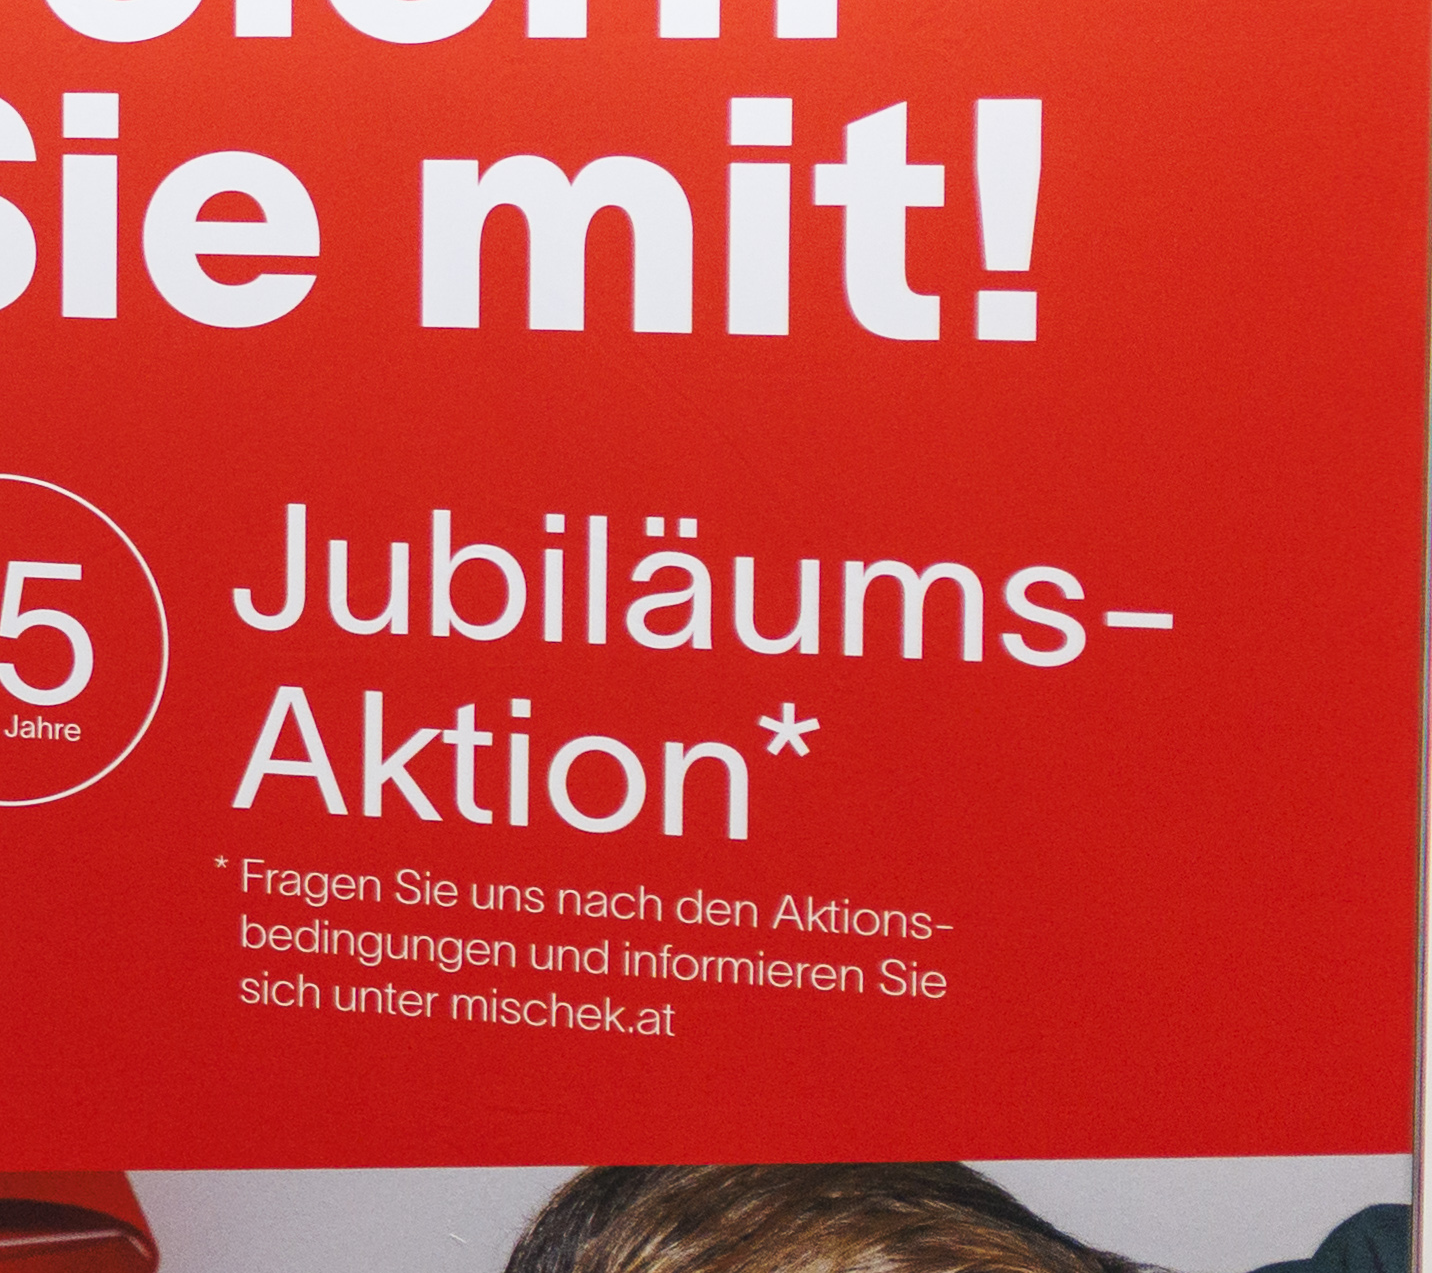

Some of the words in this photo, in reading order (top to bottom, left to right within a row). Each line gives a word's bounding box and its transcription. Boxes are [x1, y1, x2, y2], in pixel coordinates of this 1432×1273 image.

[420, 96, 1043, 343] mit!
[232, 502, 1177, 669] Jubiläums-
[4, 714, 82, 742] Jahre
[394, 867, 460, 909] Sie
[471, 881, 546, 915] uns
[557, 882, 663, 923] nach
[676, 887, 760, 930] den
[771, 894, 955, 941] Aktions-
[240, 913, 517, 974] bedingungen
[529, 936, 610, 977] und
[623, 939, 865, 994] informieren
[877, 957, 949, 1001] Sie
[240, 970, 321, 1010] sich
[333, 982, 440, 1020] unter
[450, 989, 677, 1038] mischek.at
